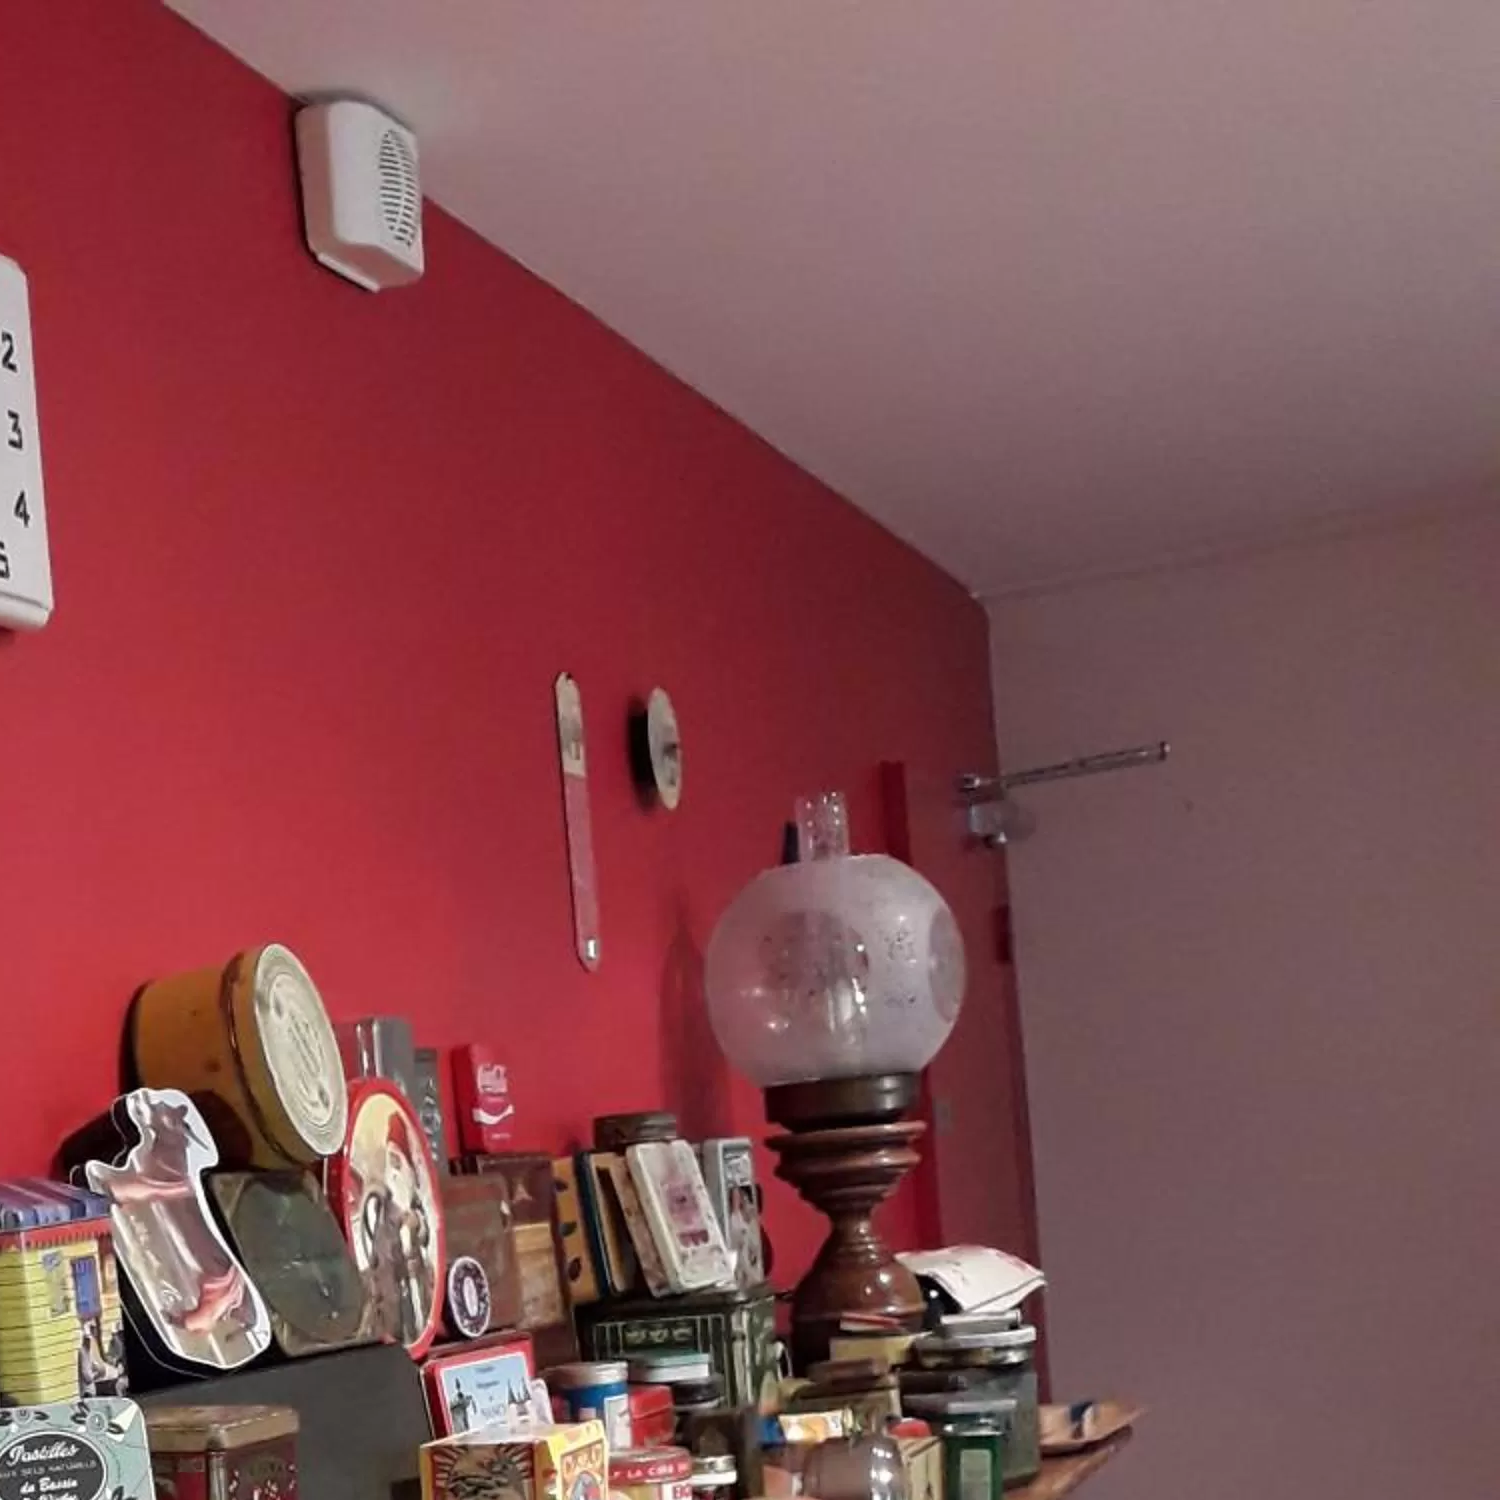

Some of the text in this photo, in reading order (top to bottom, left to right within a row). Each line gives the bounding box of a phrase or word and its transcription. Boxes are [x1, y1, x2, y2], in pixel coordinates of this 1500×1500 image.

[1, 333, 17, 372] 2
[8, 411, 23, 450] 3
[14, 491, 30, 527] 4
